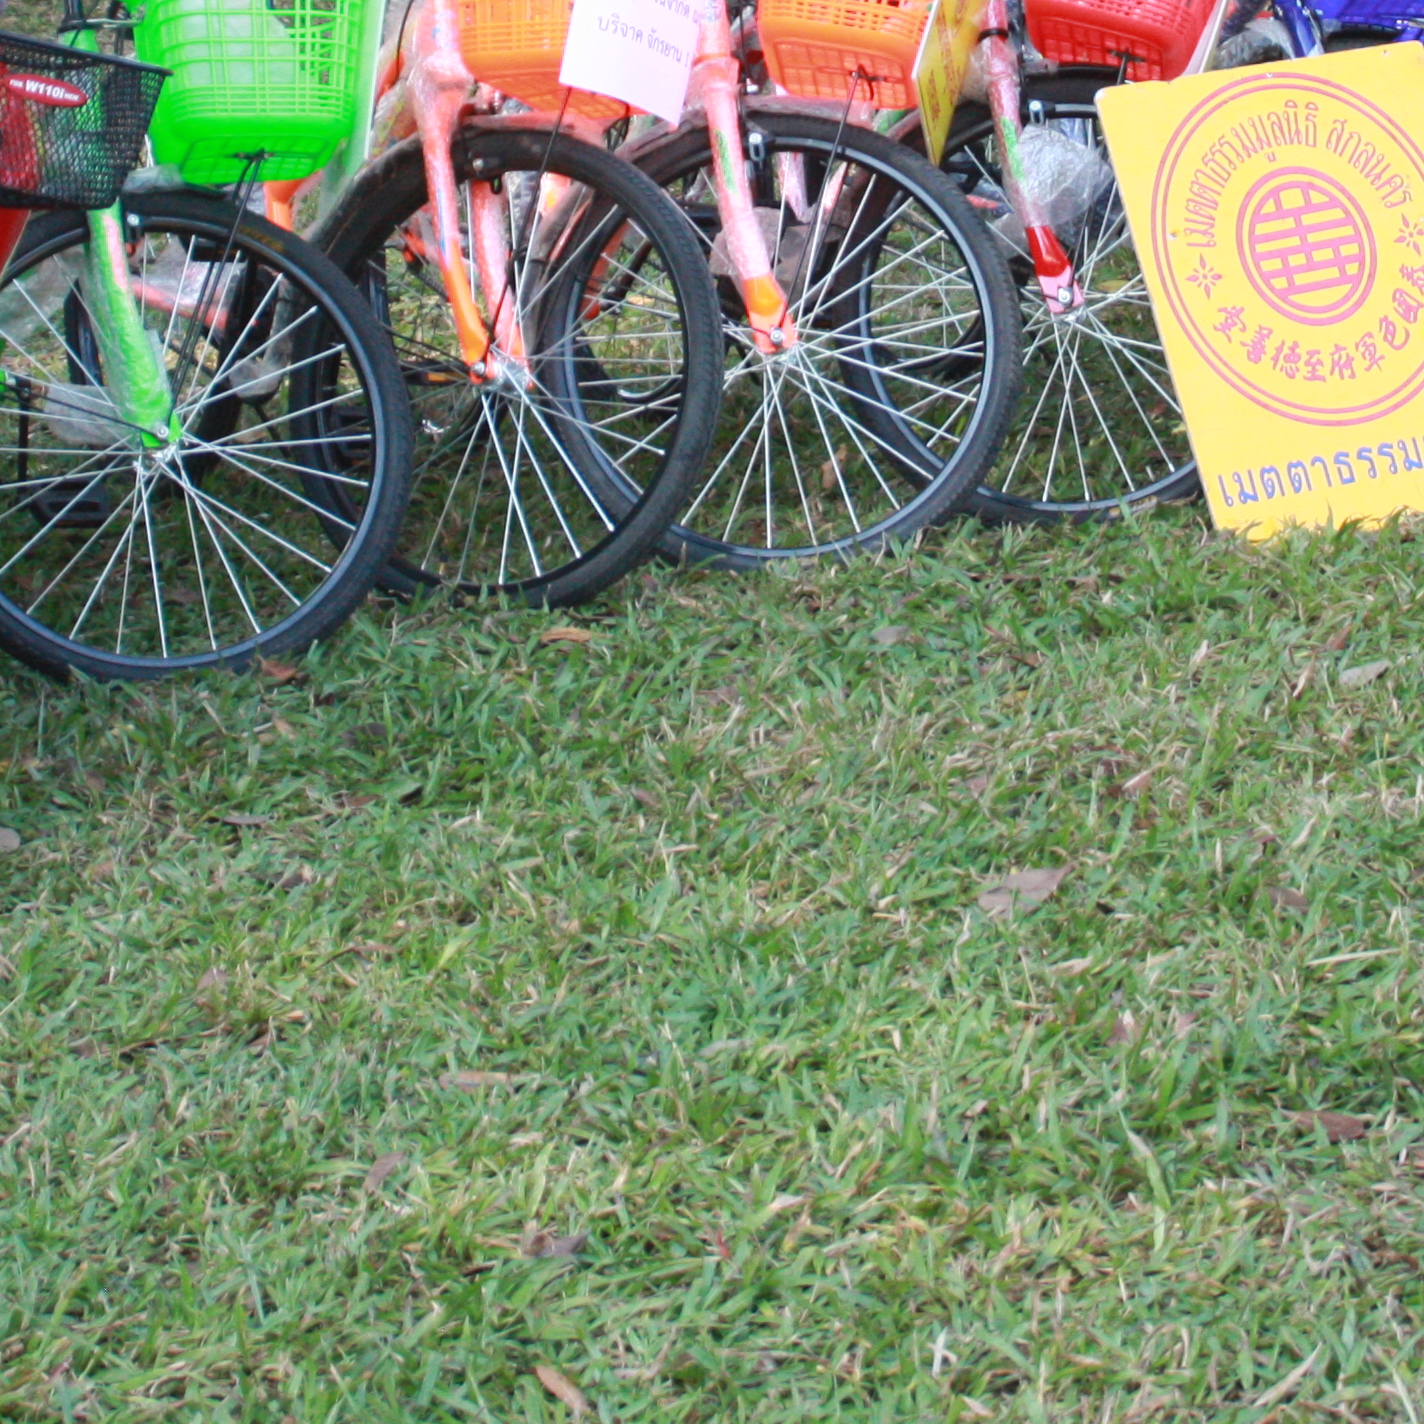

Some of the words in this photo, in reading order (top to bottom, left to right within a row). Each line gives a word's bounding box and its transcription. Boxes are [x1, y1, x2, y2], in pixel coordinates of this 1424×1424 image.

[597, 13, 644, 44] บริจาค
[647, 27, 682, 65] จักรยาน
[1183, 99, 1319, 248] เมตตาธรรมมูลนิธิ
[1325, 119, 1413, 209] สกลนคร
